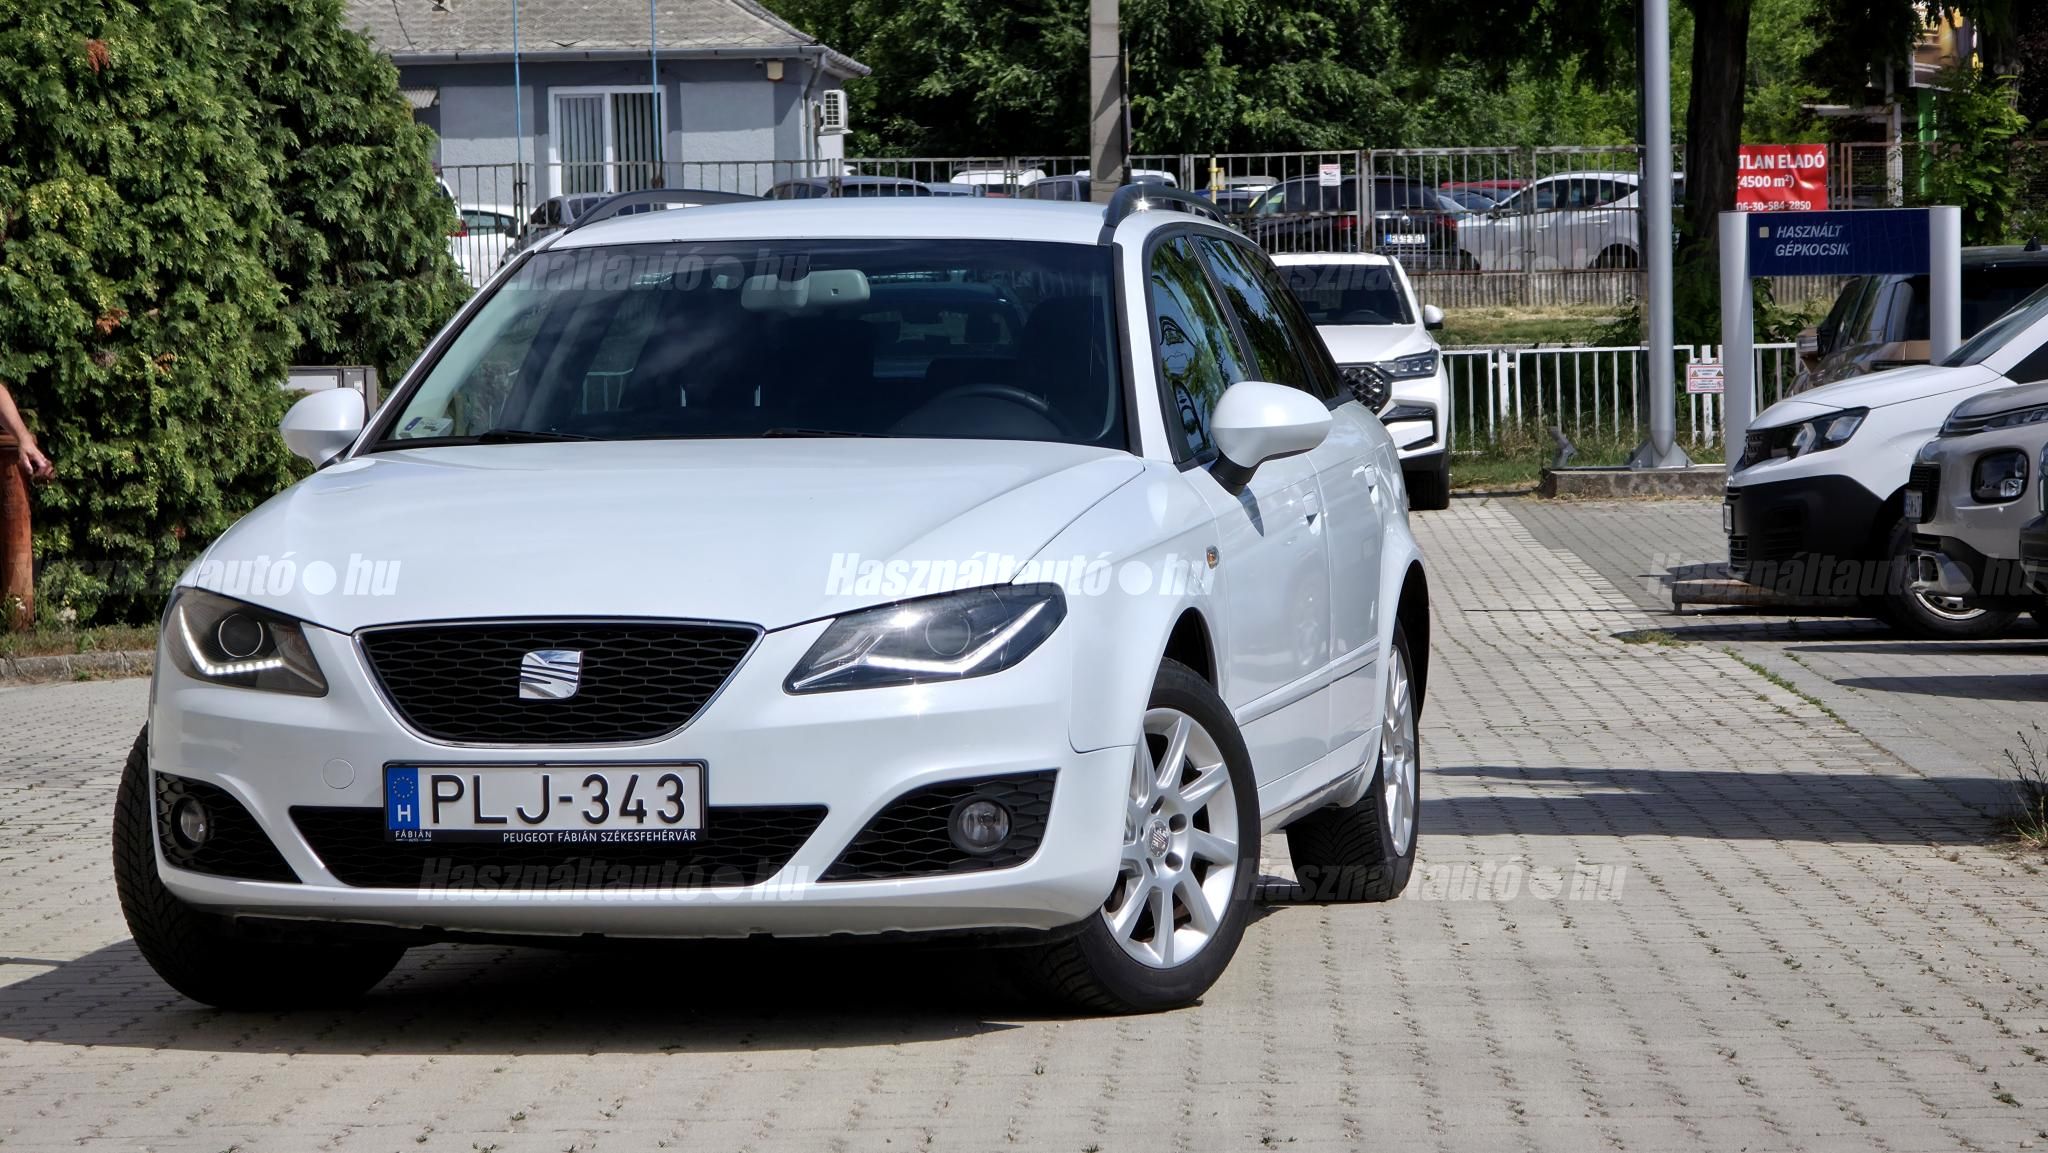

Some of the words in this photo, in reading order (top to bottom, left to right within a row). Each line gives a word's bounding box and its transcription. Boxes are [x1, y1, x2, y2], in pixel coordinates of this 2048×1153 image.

[1778, 151, 1825, 168] ELADÓ
[1776, 221, 1843, 238] HASZNÁLT
[1775, 240, 1850, 256] GÉPKOCSIK
[430, 773, 686, 826] PLJ-343
[397, 804, 411, 822] H
[395, 829, 432, 838] FÁBIÁN
[503, 832, 554, 843] PEUGEOT
[557, 831, 597, 842] FÁBIÁN
[600, 829, 697, 842] SZÉKESFEHÉRVÁR
